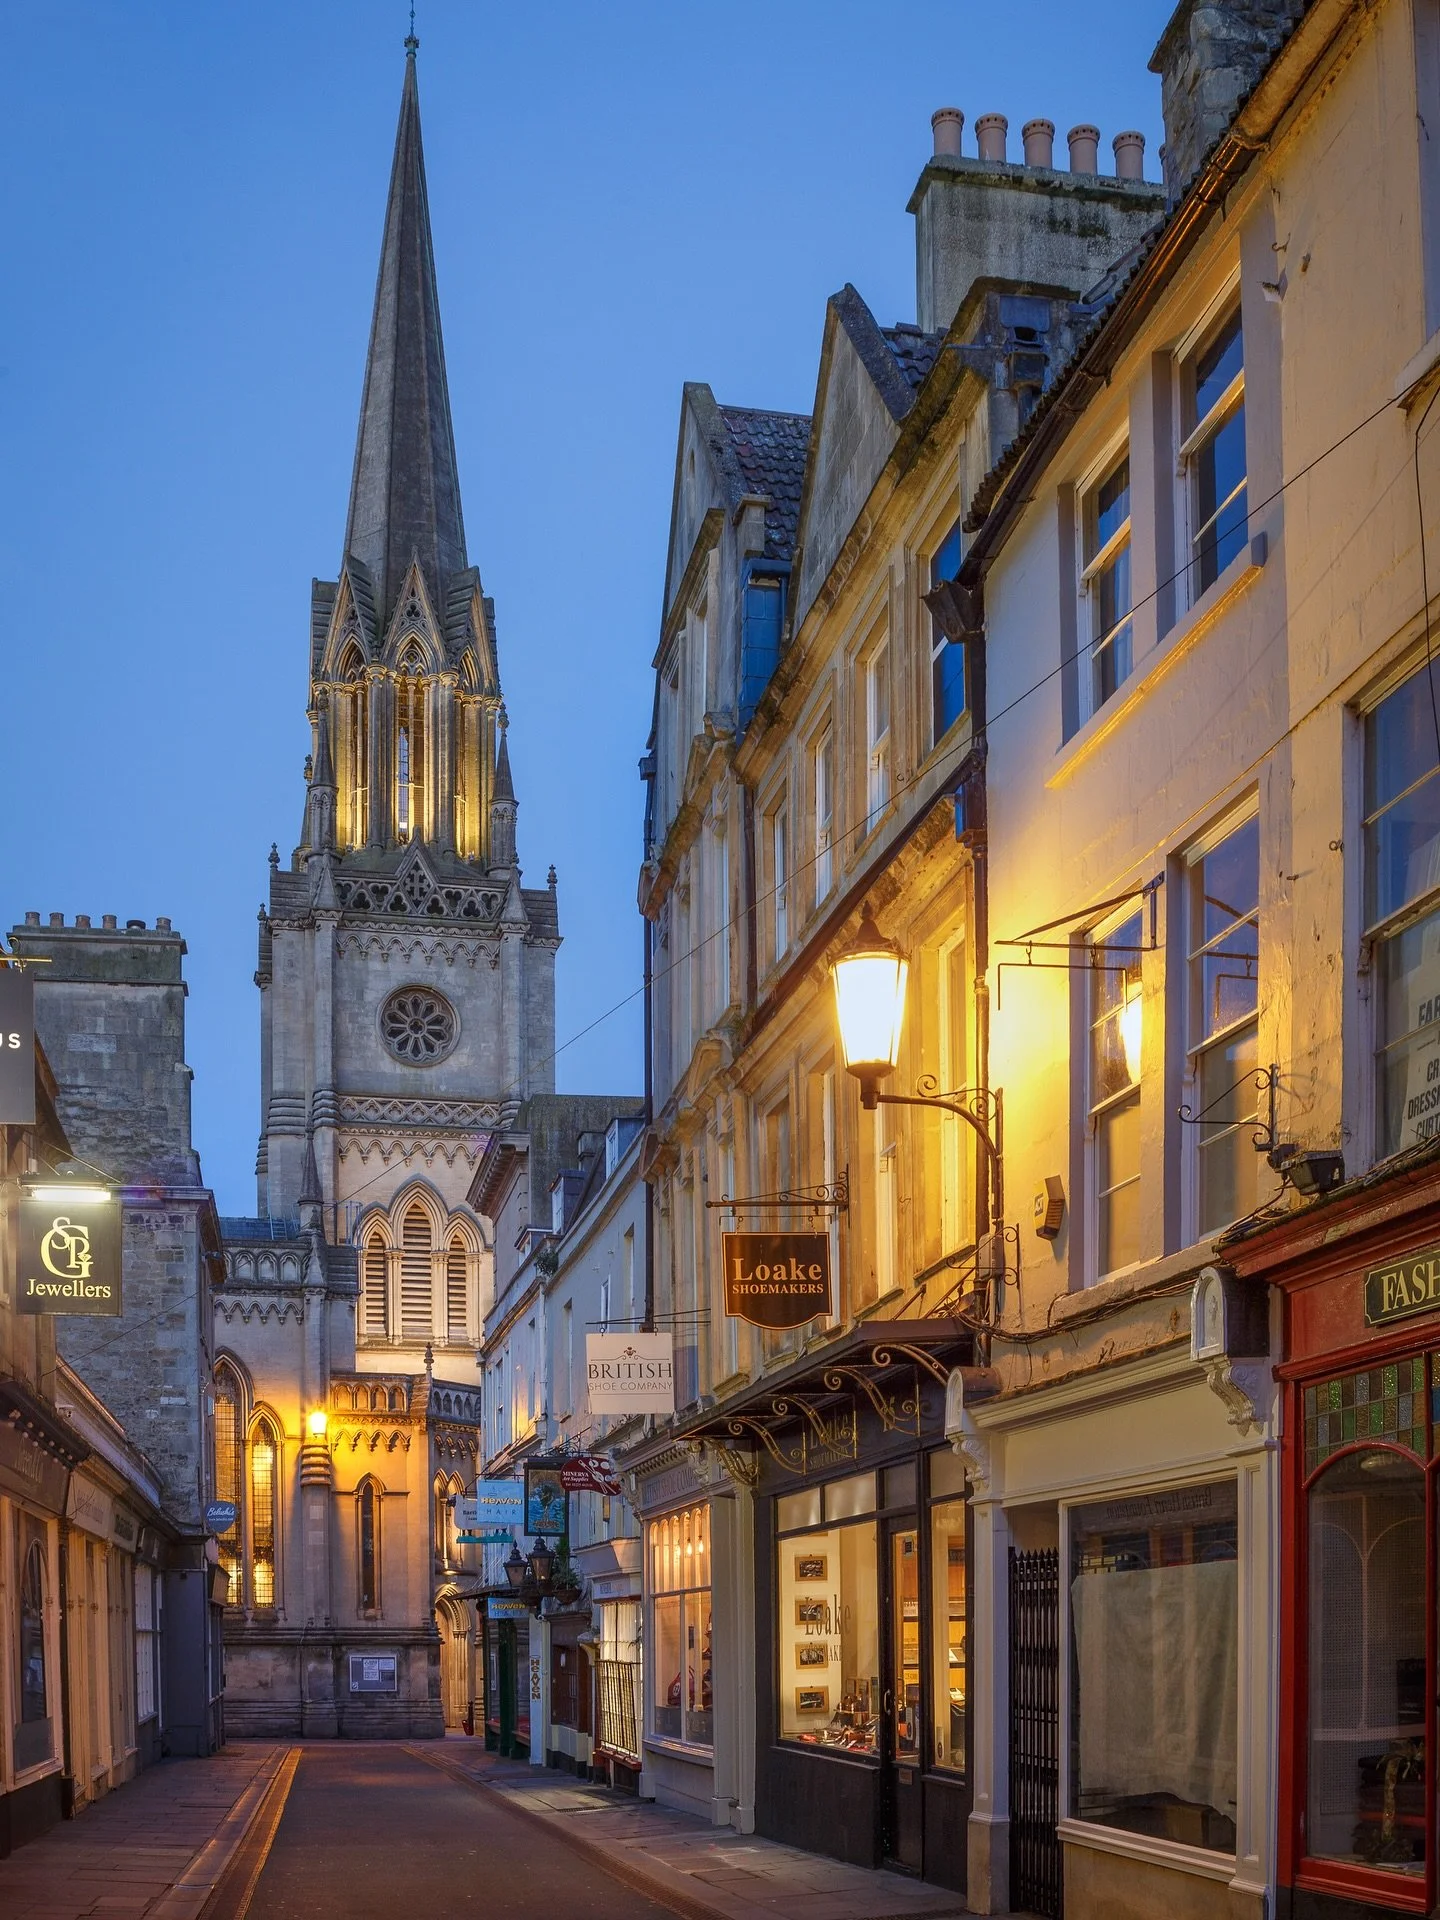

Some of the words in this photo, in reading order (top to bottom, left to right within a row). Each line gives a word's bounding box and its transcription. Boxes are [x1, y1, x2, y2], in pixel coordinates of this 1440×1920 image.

[0, 1033, 21, 1049] S
[732, 1257, 823, 1281] Loake
[26, 1278, 112, 1298] Jewellers
[732, 1283, 824, 1295] SHOEMAKERS
[588, 1362, 673, 1379] BRITISH
[588, 1382, 617, 1391] SHOE
[620, 1381, 673, 1391] COMPANY
